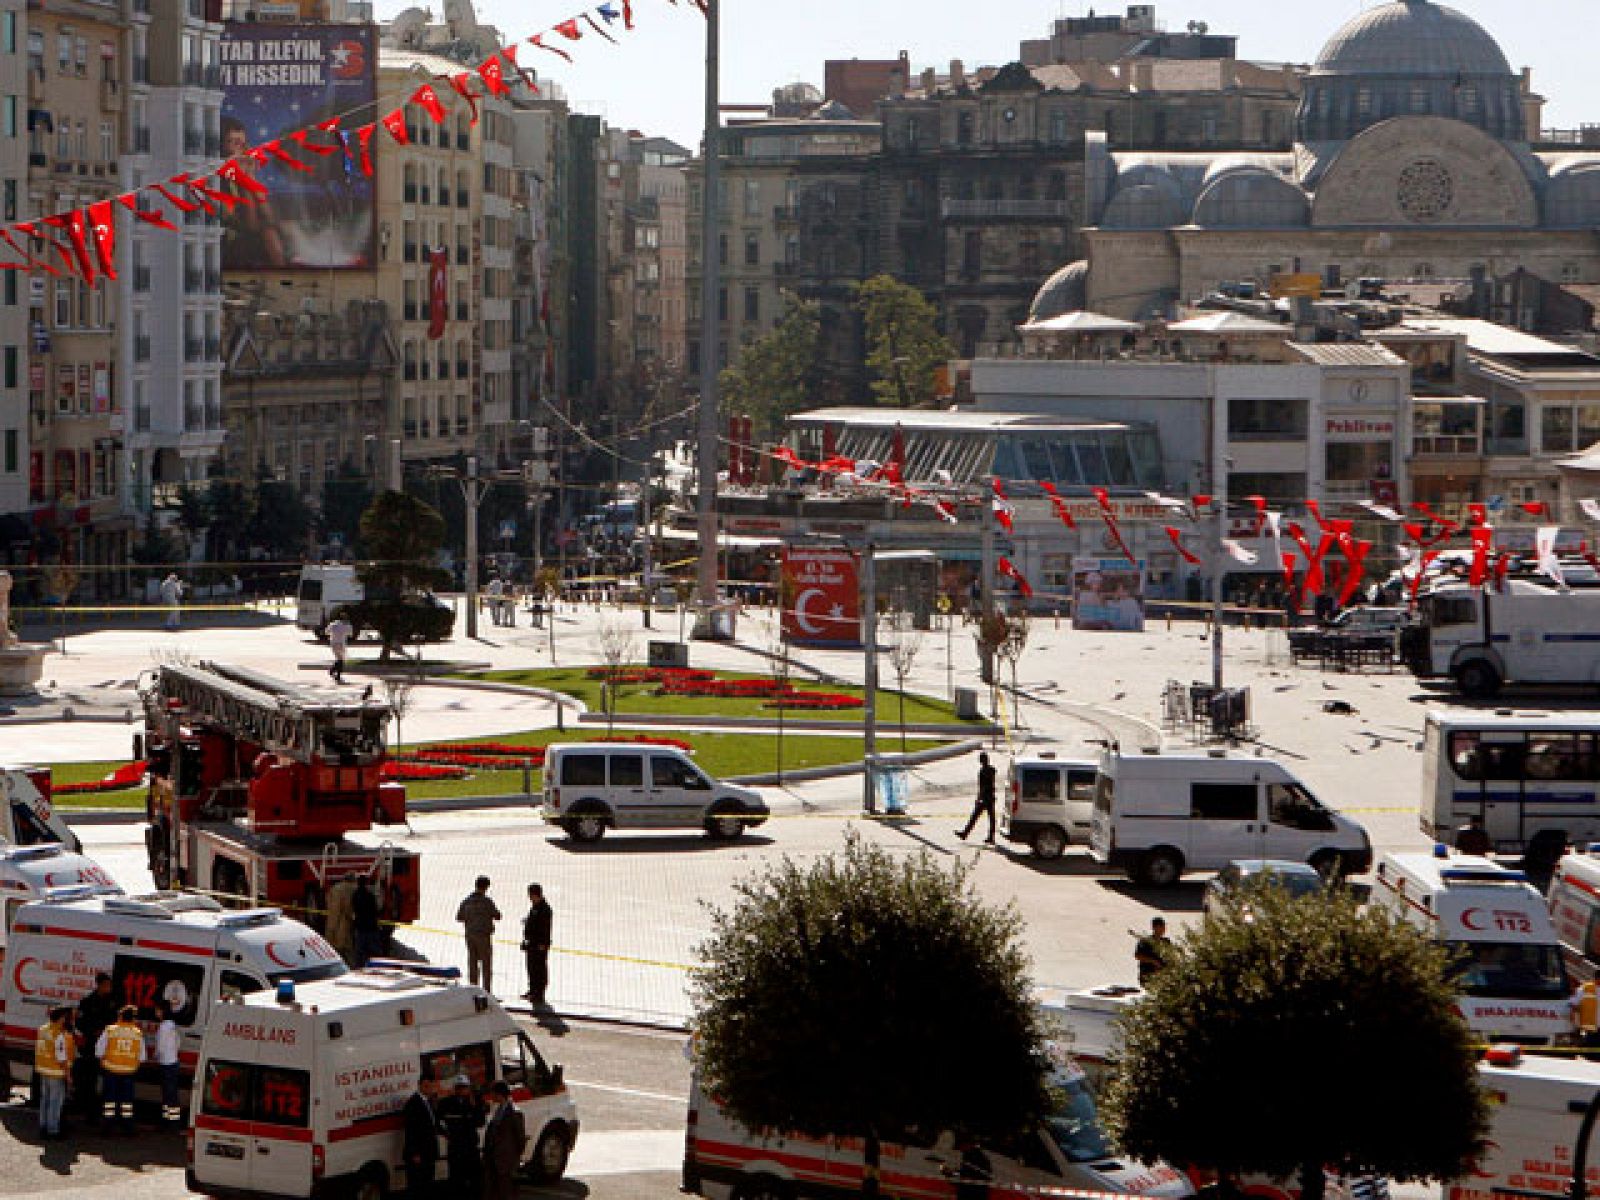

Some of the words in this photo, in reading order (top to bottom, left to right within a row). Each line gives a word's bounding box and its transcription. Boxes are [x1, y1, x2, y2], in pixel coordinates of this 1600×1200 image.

[1494, 918, 1533, 933] 112
[123, 972, 158, 1008] 112
[222, 1021, 297, 1046] AMBULANS
